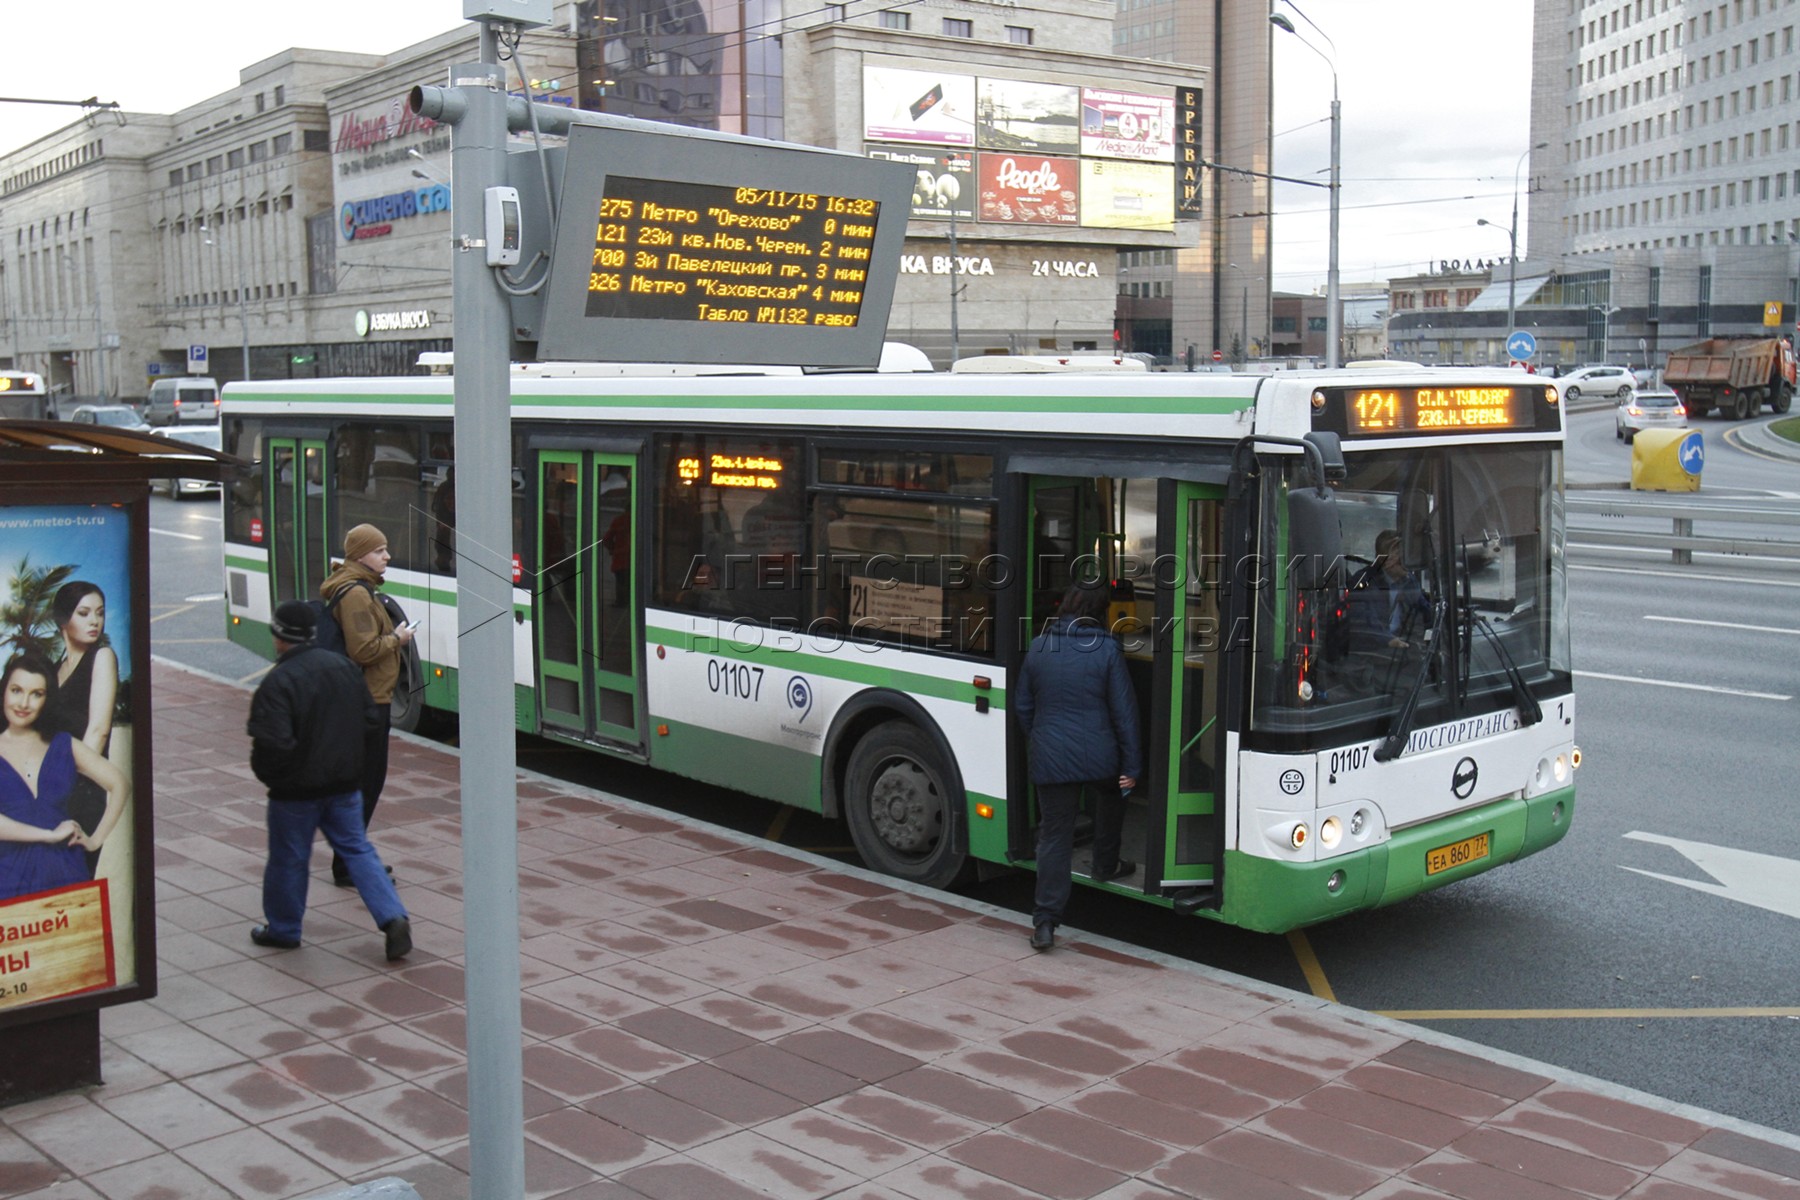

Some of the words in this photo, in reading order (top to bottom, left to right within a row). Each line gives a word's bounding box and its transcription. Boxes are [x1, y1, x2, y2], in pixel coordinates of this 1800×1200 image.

[1096, 139, 1127, 153] Media
[1184, 91, 1196, 199] ЕРЕВАН
[996, 158, 1061, 195] People
[735, 187, 818, 210] 05/11/15
[826, 197, 874, 216] 16:32
[600, 199, 633, 218] 275
[642, 202, 698, 223] Метро
[708, 208, 802, 230] "Орехово"
[824, 218, 836, 235] 0
[843, 224, 874, 237] мин
[596, 224, 626, 243] 121
[638, 227, 673, 245] 23й
[819, 241, 832, 257] 2
[838, 246, 869, 260] мин
[634, 251, 658, 269] 3й
[667, 253, 772, 276] Павелецкий
[780, 265, 808, 278] пр.
[816, 264, 828, 280] 3
[834, 268, 865, 281] мин
[1032, 260, 1049, 276] 24
[1052, 260, 1099, 278] ЧАСА
[630, 275, 686, 294] Метро
[697, 279, 808, 300] "Каховская"
[812, 286, 824, 301] 4
[830, 290, 861, 304] мин
[370, 313, 401, 331] АЗБУКА
[401, 310, 430, 329] ВКУСА
[698, 304, 749, 322] Табло
[815, 313, 857, 327] рабо
[1355, 393, 1398, 427] 121
[708, 659, 764, 702] 01107
[1405, 711, 1511, 755] МОСГОРТРАНС
[1331, 746, 1369, 774] 01107
[1451, 843, 1470, 864] 860
[1475, 836, 1484, 851] 77
